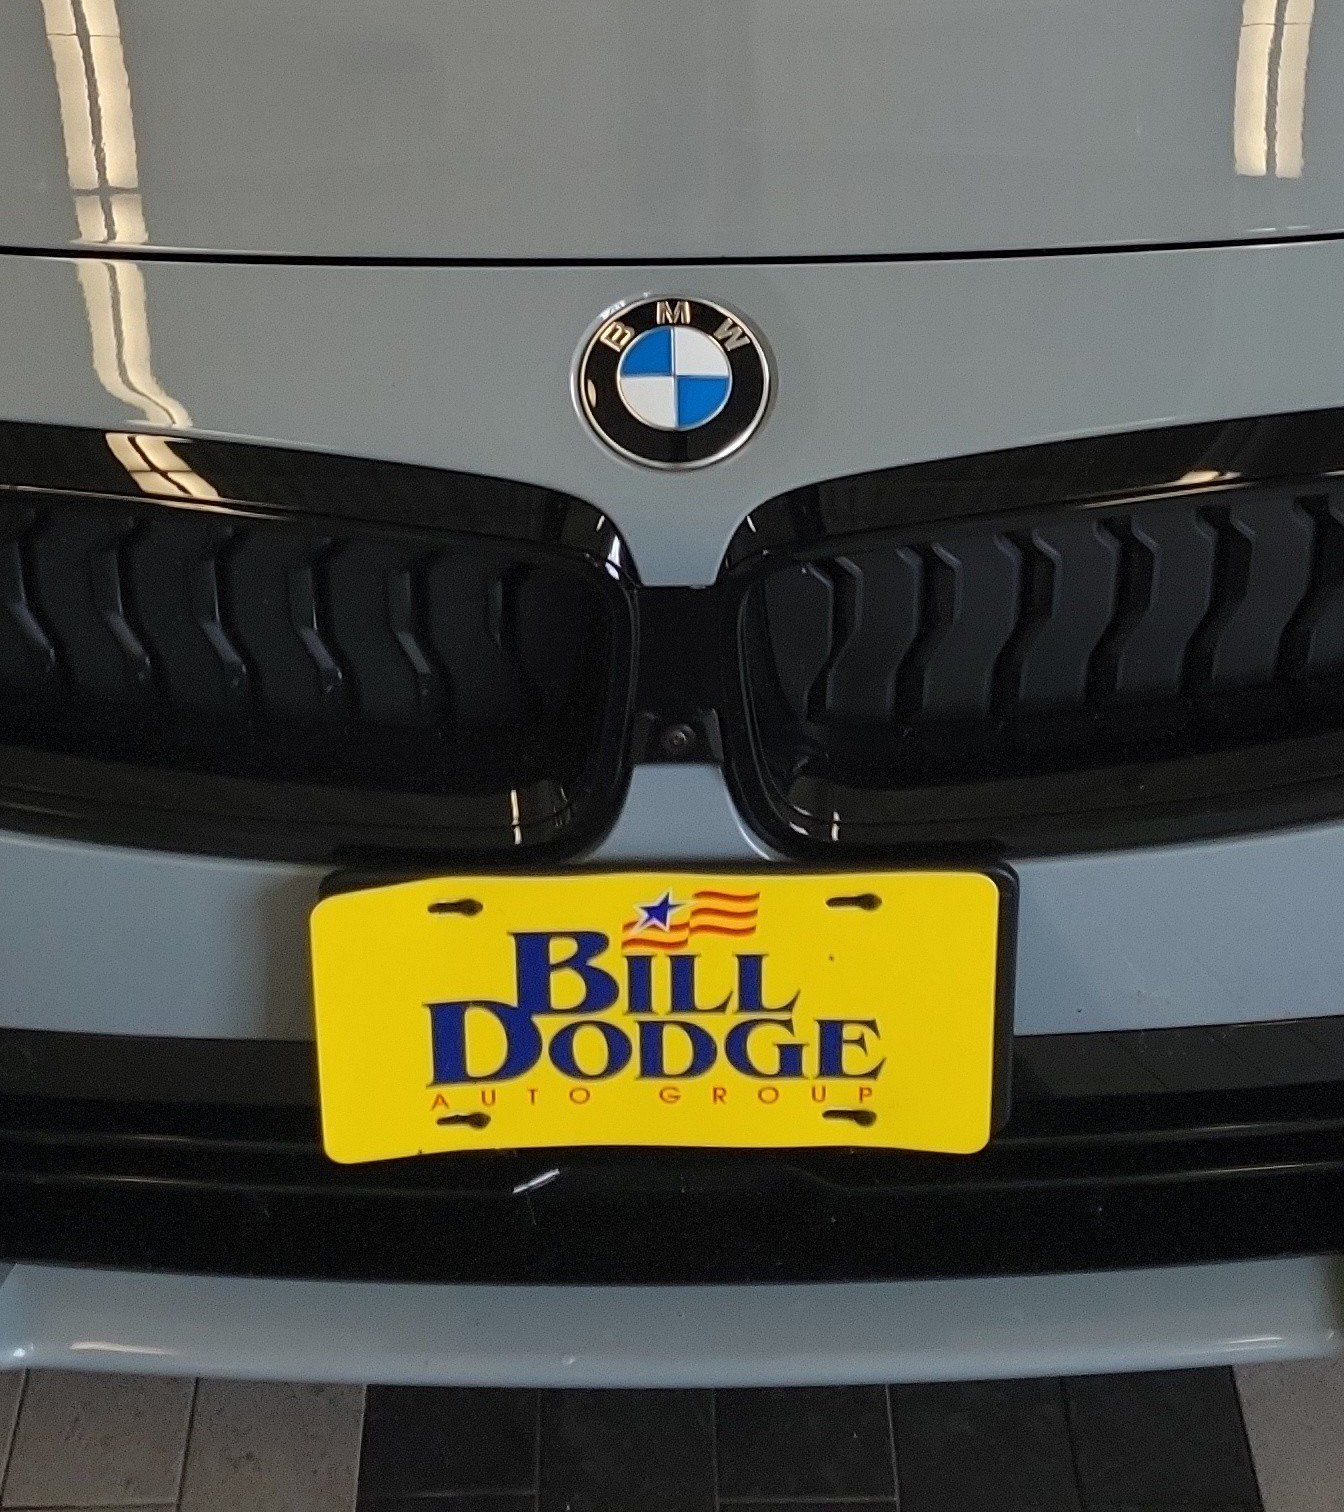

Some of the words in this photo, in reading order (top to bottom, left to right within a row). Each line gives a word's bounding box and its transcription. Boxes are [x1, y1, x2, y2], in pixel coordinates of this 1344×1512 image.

[599, 300, 751, 353] BMW
[507, 929, 801, 1016] BILL
[422, 999, 887, 1087] DODGE
[430, 1087, 592, 1111] AUTO
[658, 1085, 874, 1105] GROUP
